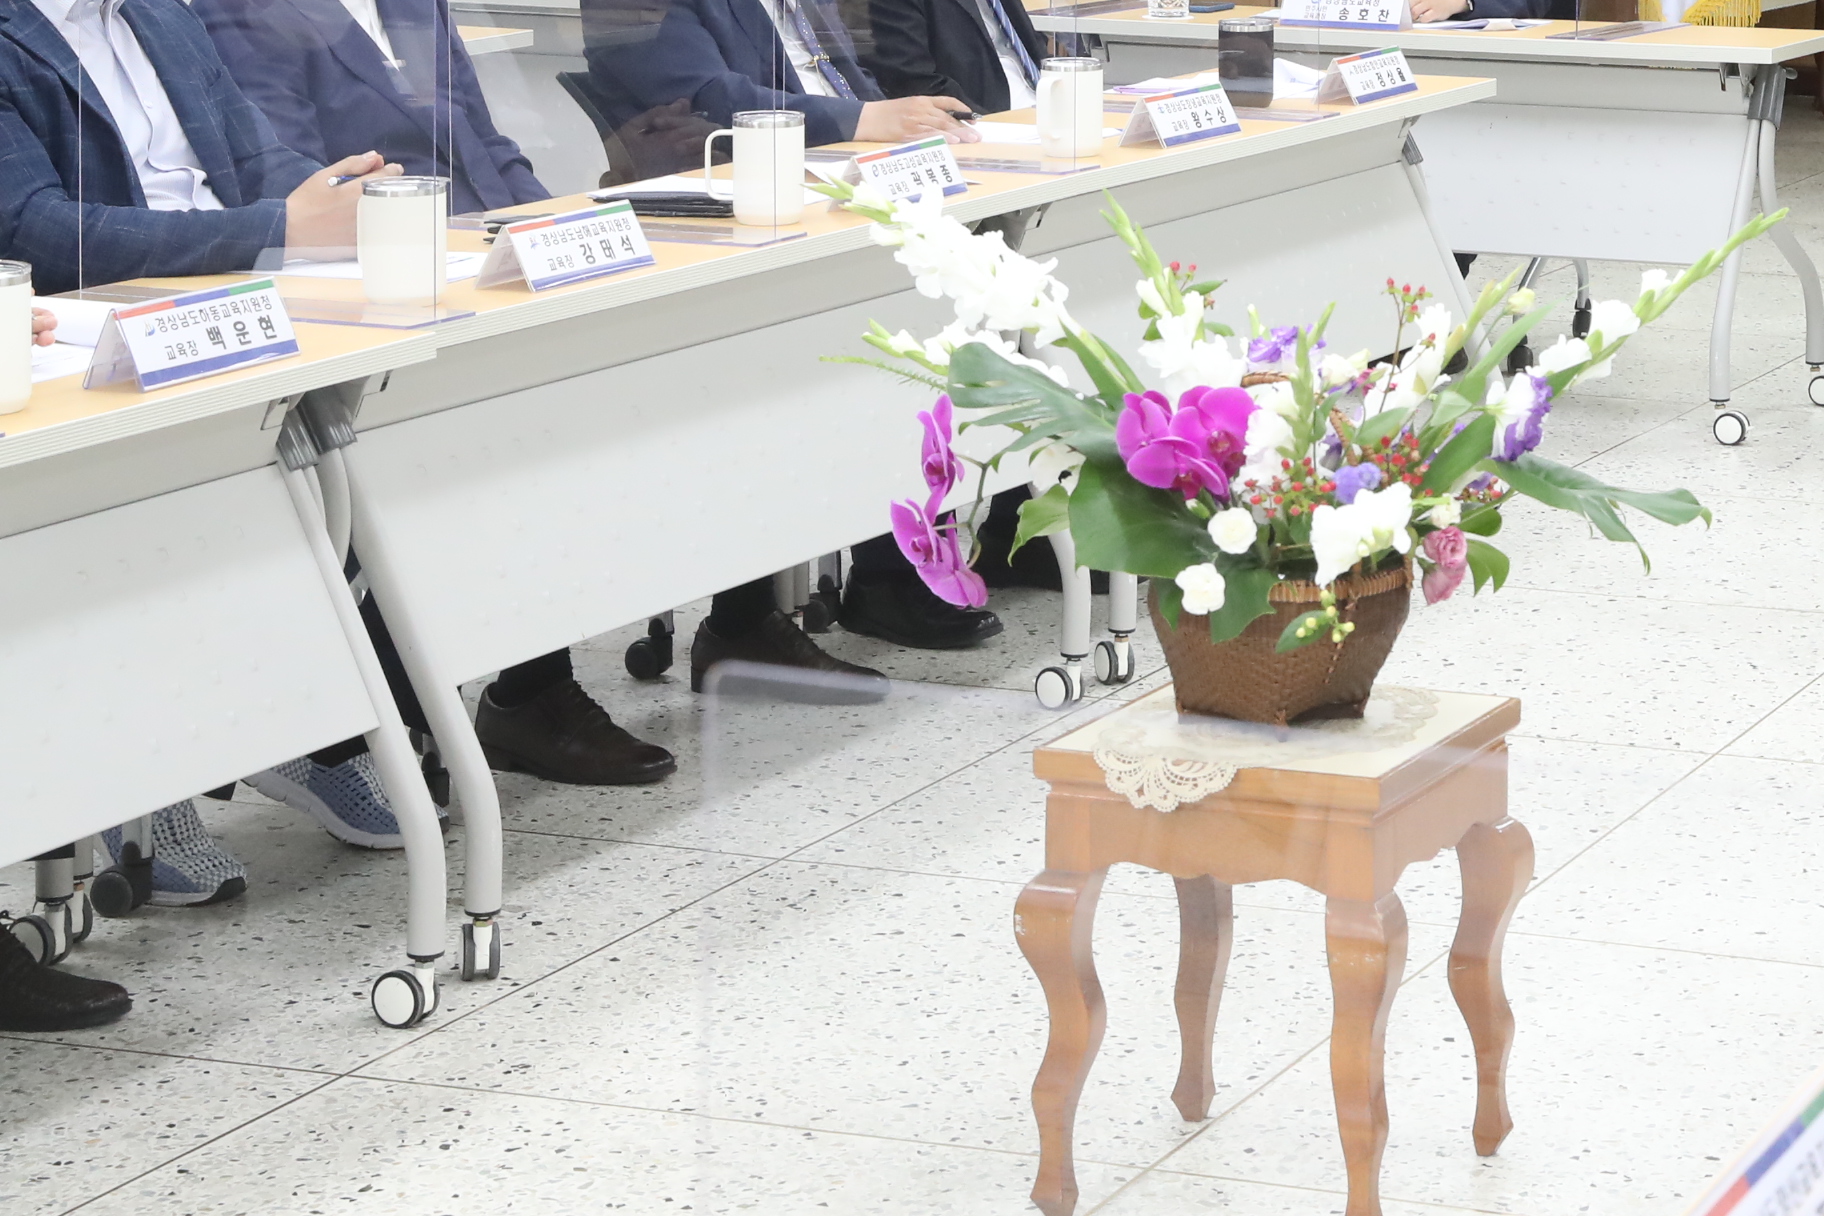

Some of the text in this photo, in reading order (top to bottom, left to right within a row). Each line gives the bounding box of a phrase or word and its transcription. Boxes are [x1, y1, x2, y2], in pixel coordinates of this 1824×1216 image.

[547, 254, 575, 272] 교육장
[154, 294, 273, 334] 경상남도하동교육지원청
[164, 339, 200, 361] 교육장
